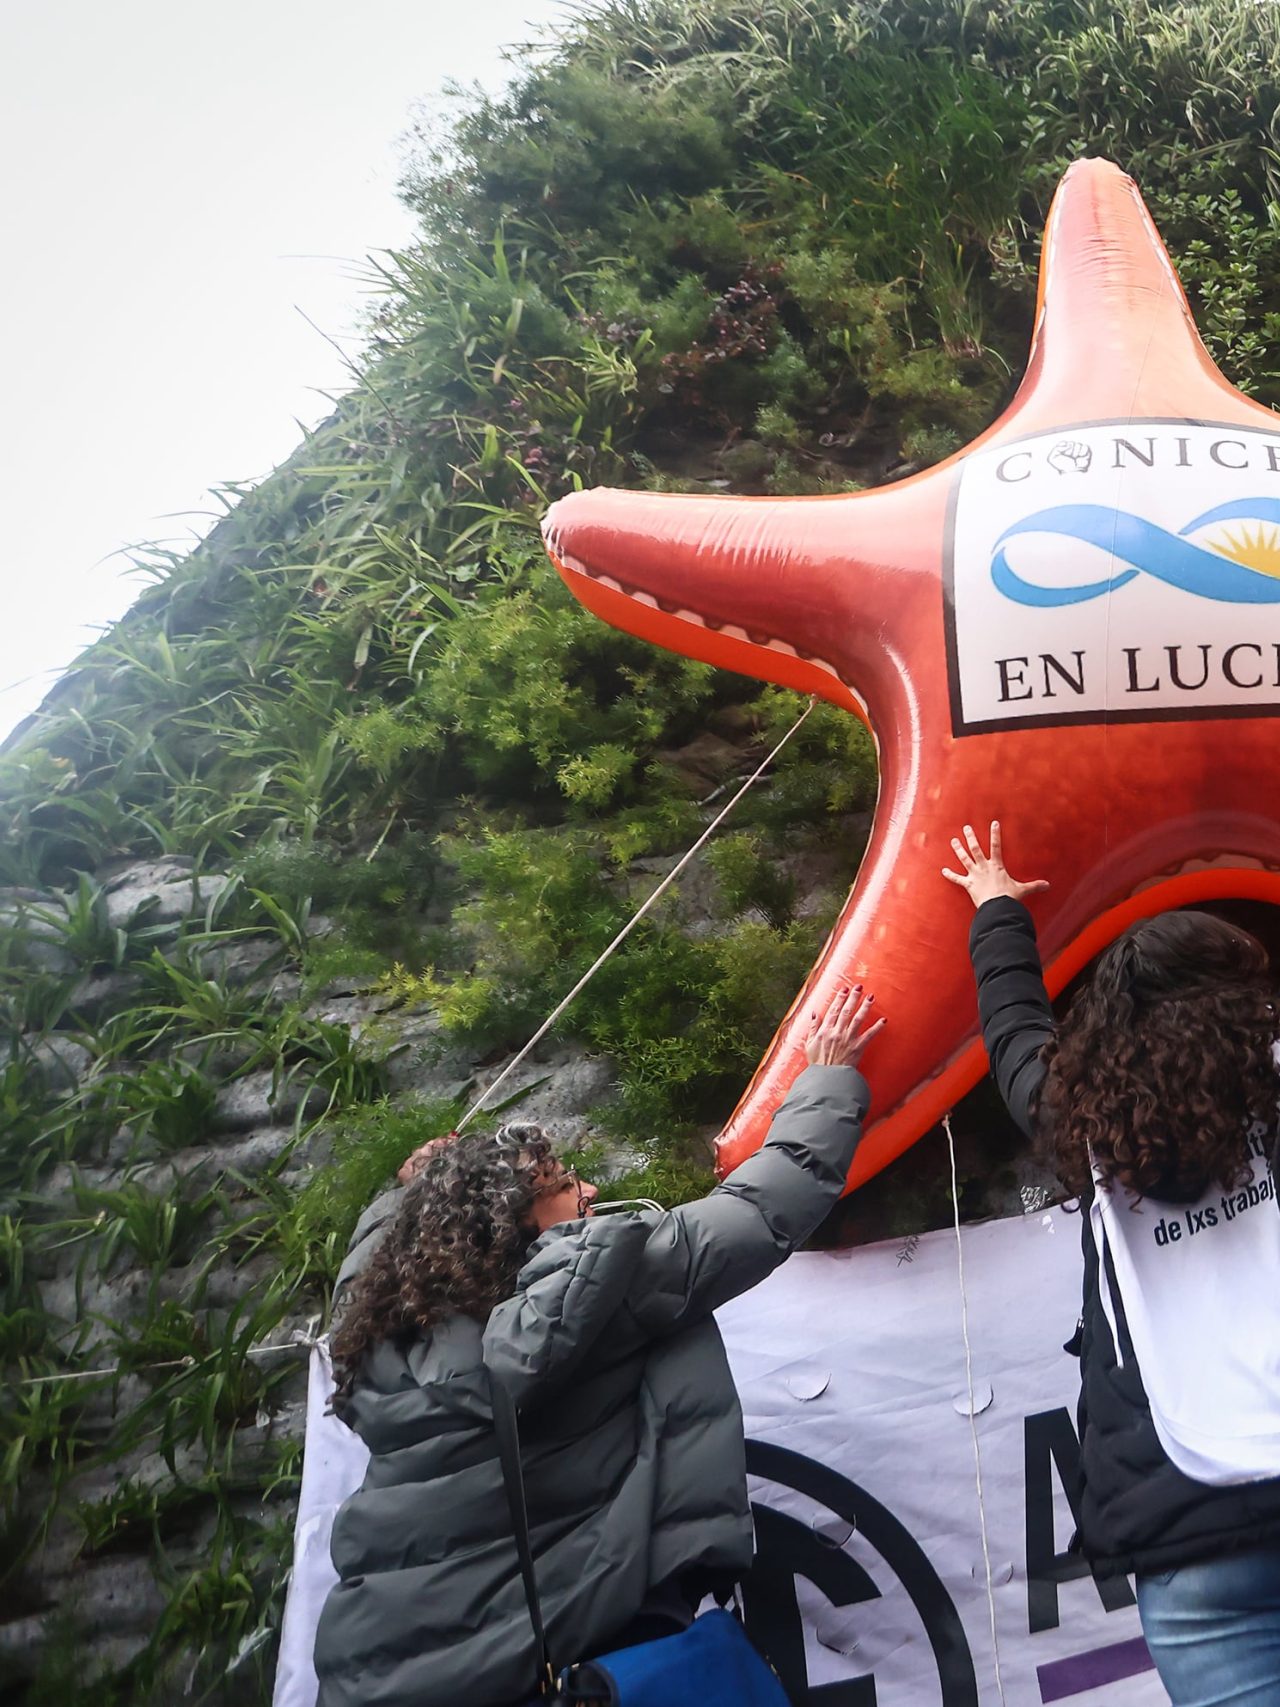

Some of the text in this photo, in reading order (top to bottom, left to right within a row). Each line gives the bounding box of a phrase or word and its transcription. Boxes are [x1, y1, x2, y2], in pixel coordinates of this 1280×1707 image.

[994, 650, 1087, 702] EN
[1154, 1174, 1276, 1247] de lxs trabaj
